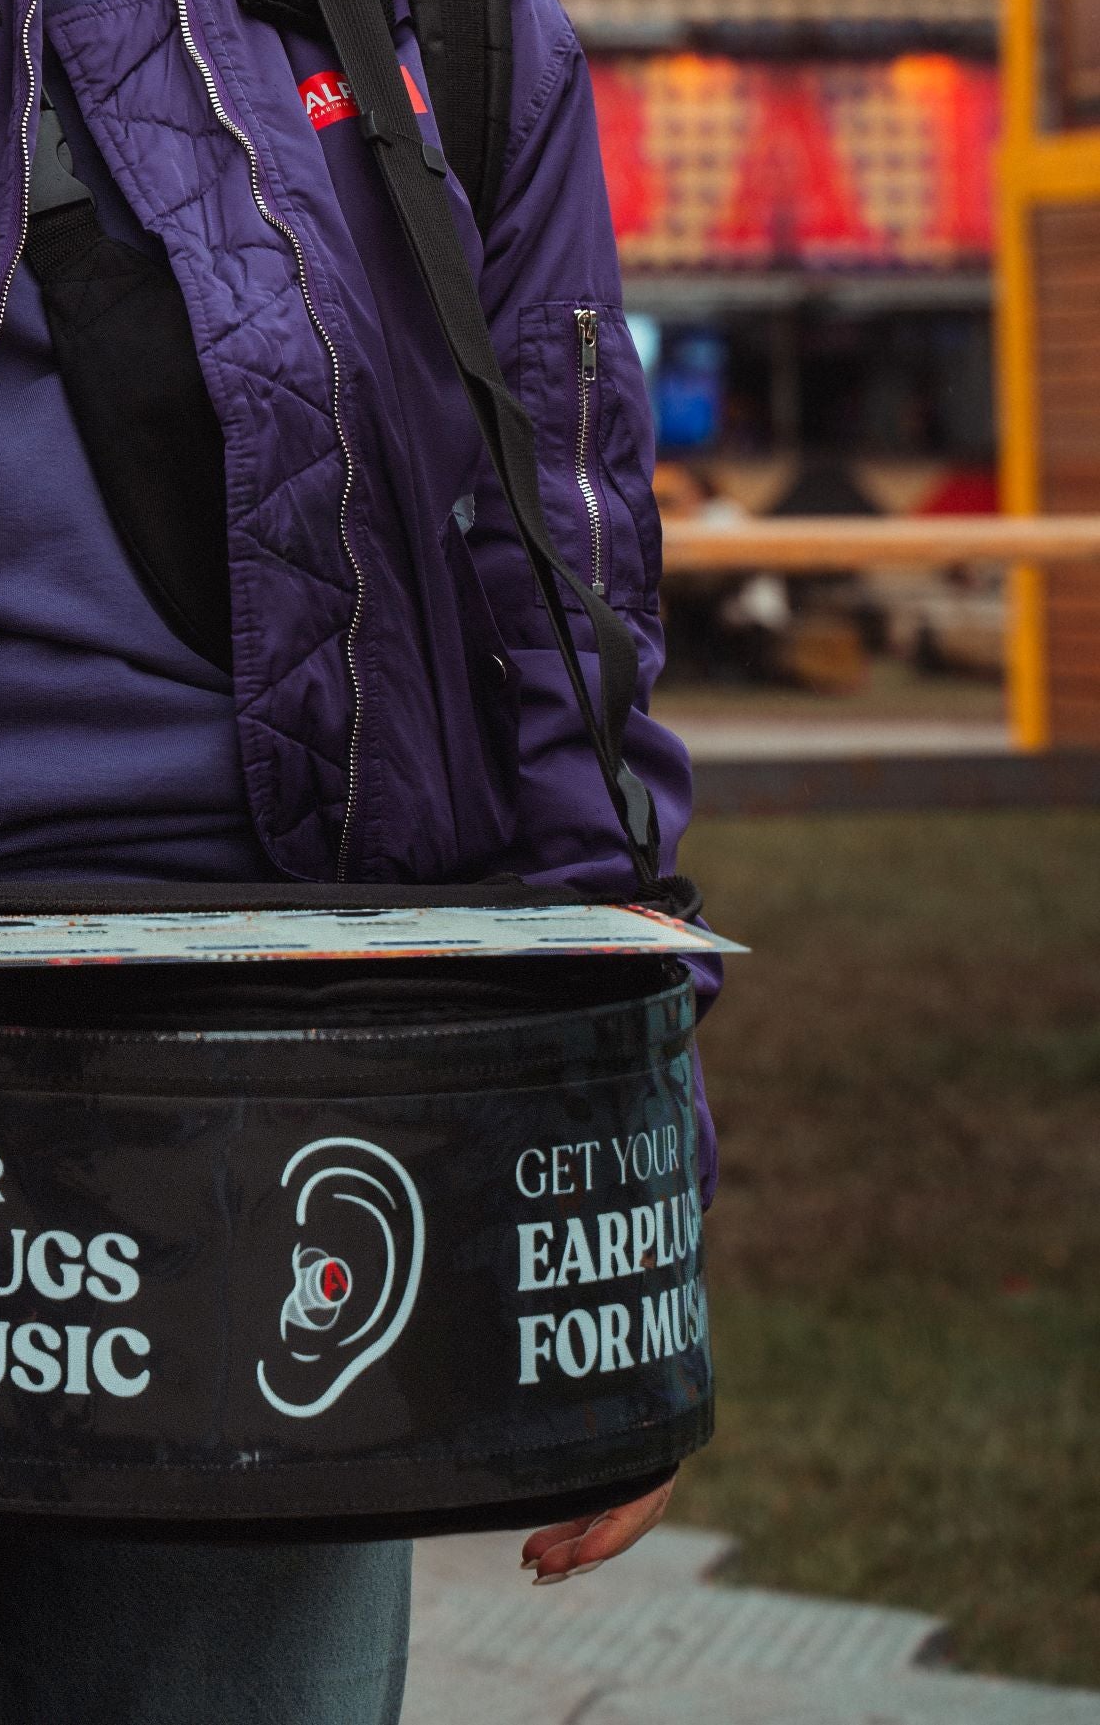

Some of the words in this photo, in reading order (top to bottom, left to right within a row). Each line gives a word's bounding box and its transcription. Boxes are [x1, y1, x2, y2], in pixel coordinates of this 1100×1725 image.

[306, 81, 352, 115] ALP
[516, 1141, 600, 1198] GET
[612, 1125, 680, 1184] YOUR
[517, 1187, 701, 1292] EARPLUG
[517, 1303, 635, 1384] FOR
[641, 1276, 706, 1364] MUS
